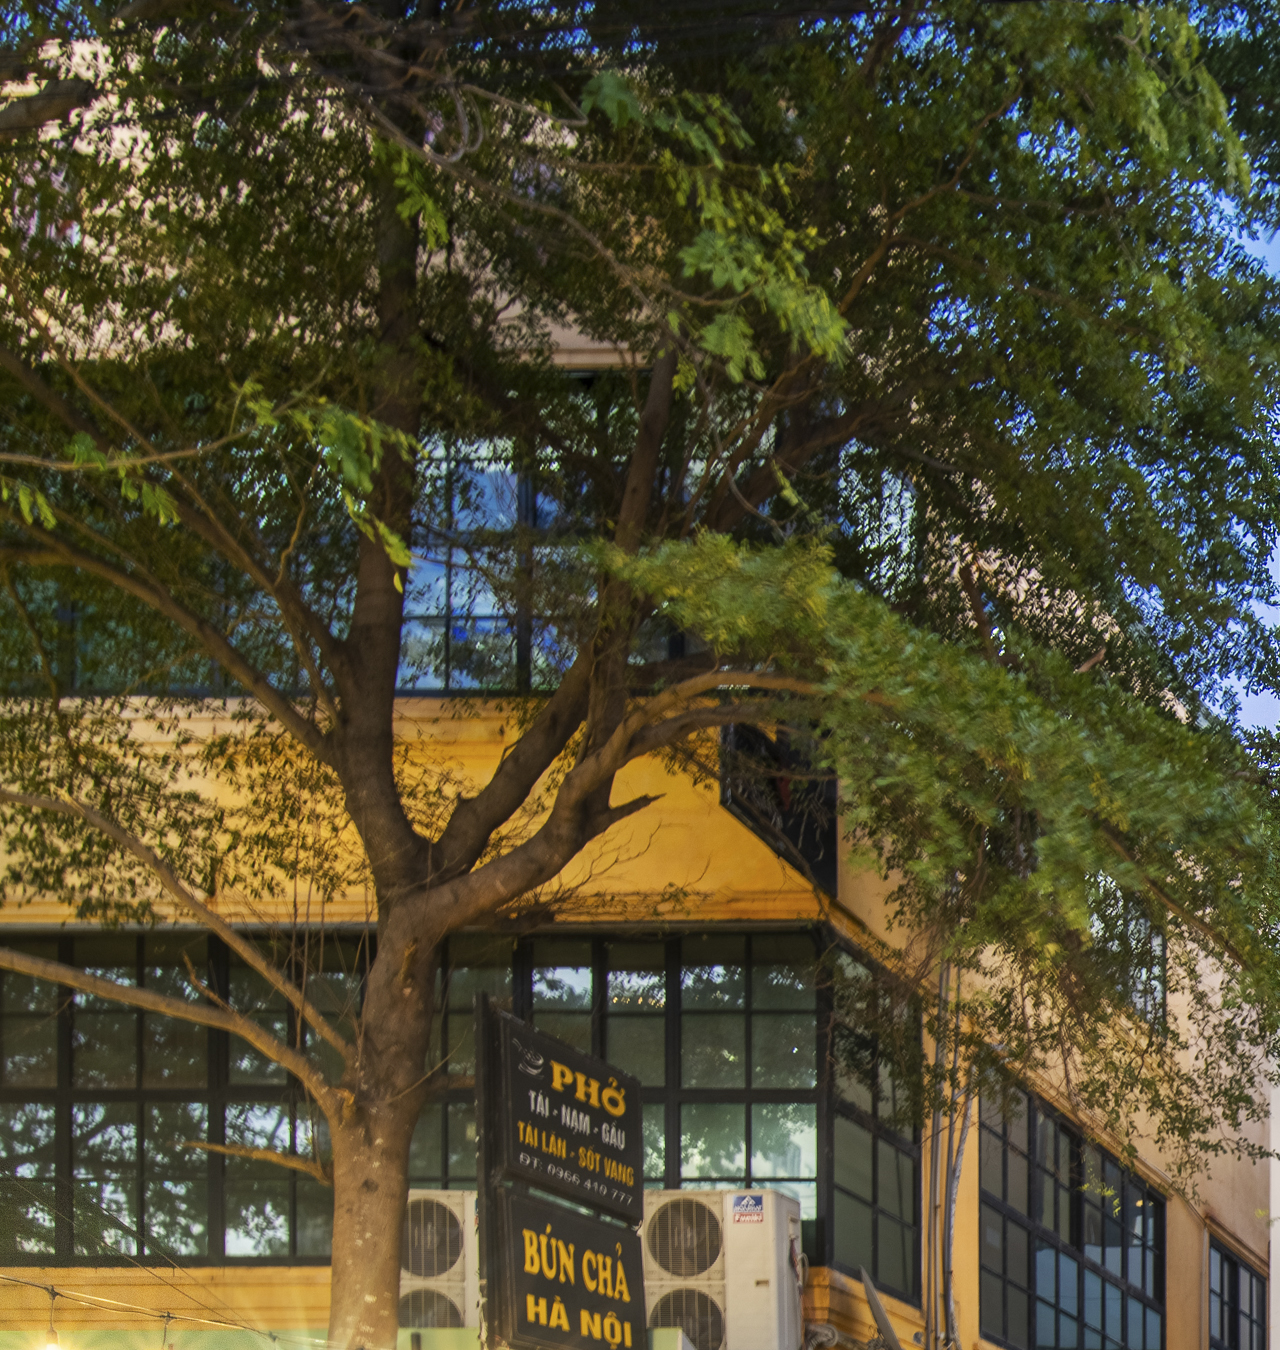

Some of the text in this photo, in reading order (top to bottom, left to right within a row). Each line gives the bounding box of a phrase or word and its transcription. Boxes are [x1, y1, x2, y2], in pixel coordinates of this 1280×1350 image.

[528, 1089, 550, 1119] TÁI
[561, 1103, 591, 1137] NẠM
[550, 1060, 626, 1118] PHỞ
[517, 1119, 539, 1150] TÁI
[603, 1156, 635, 1188] VANG
[547, 1163, 581, 1186] 0966
[610, 1187, 634, 1206] 777
[522, 1223, 631, 1303] BÚN CHẢ
[525, 1293, 633, 1350] HÀ NỘI
